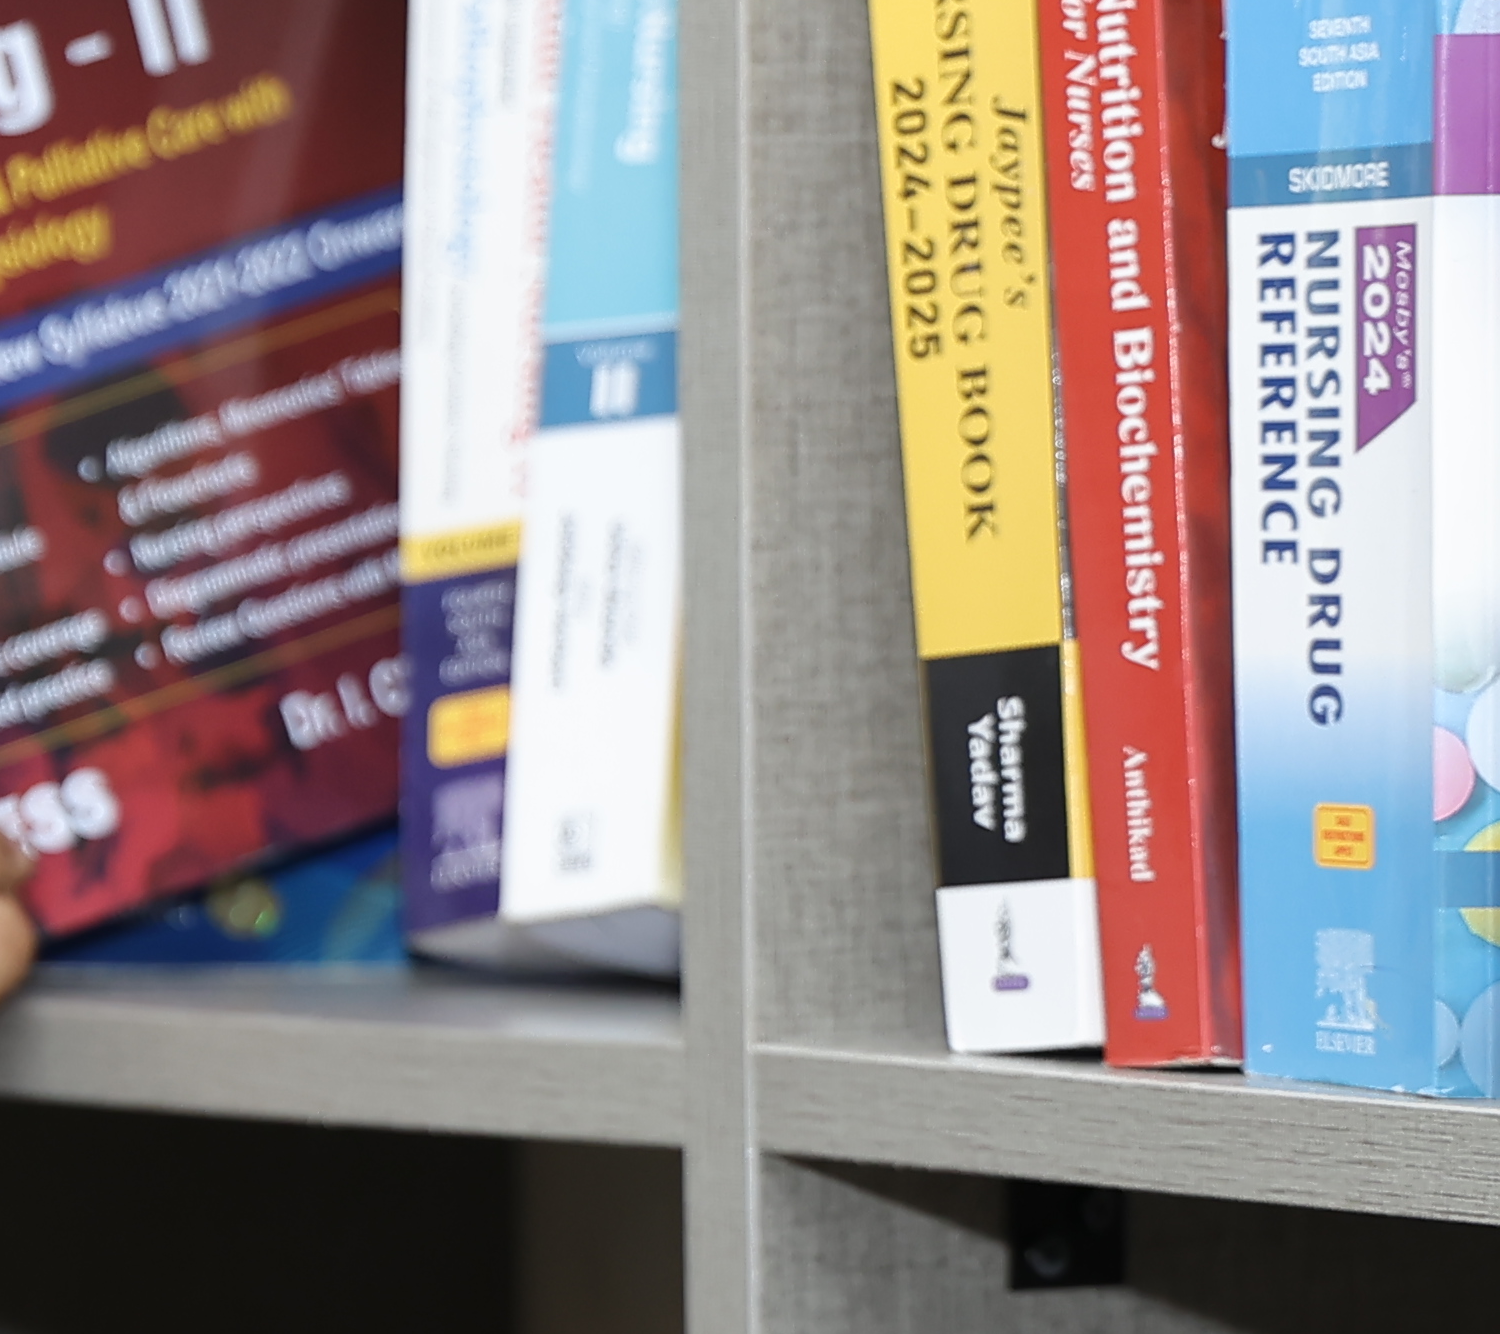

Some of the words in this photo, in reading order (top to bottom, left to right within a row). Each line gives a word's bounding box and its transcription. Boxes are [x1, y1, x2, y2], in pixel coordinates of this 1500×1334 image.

[1298, 44, 1347, 67] SOUTH
[1348, 41, 1381, 63] ASIA
[1309, 15, 1372, 41] SEVENTH
[1311, 68, 1369, 93] EDITION
[146, 101, 224, 159] Care
[222, 72, 291, 131] with
[1064, 50, 1098, 193] Nurses
[1287, 160, 1391, 195] SKIDMORE
[890, 77, 943, 361] 2024-2025
[941, 172, 994, 348] DRUG
[990, 97, 1030, 309] Jaypee's
[1105, 213, 1150, 313] and
[37, 286, 169, 367] Syllabus
[1303, 228, 1346, 520] NURSING
[1361, 243, 1393, 397] 2024
[956, 364, 999, 542] BOOK
[1257, 231, 1299, 567] REFERENCE
[1112, 326, 1166, 673] Biochemistry
[1305, 545, 1347, 728] DRUG
[966, 712, 998, 833] Yadav
[997, 694, 1029, 844] Sharma
[1121, 742, 1158, 884] Anthikad
[1315, 1029, 1376, 1056] ELSEVIER
